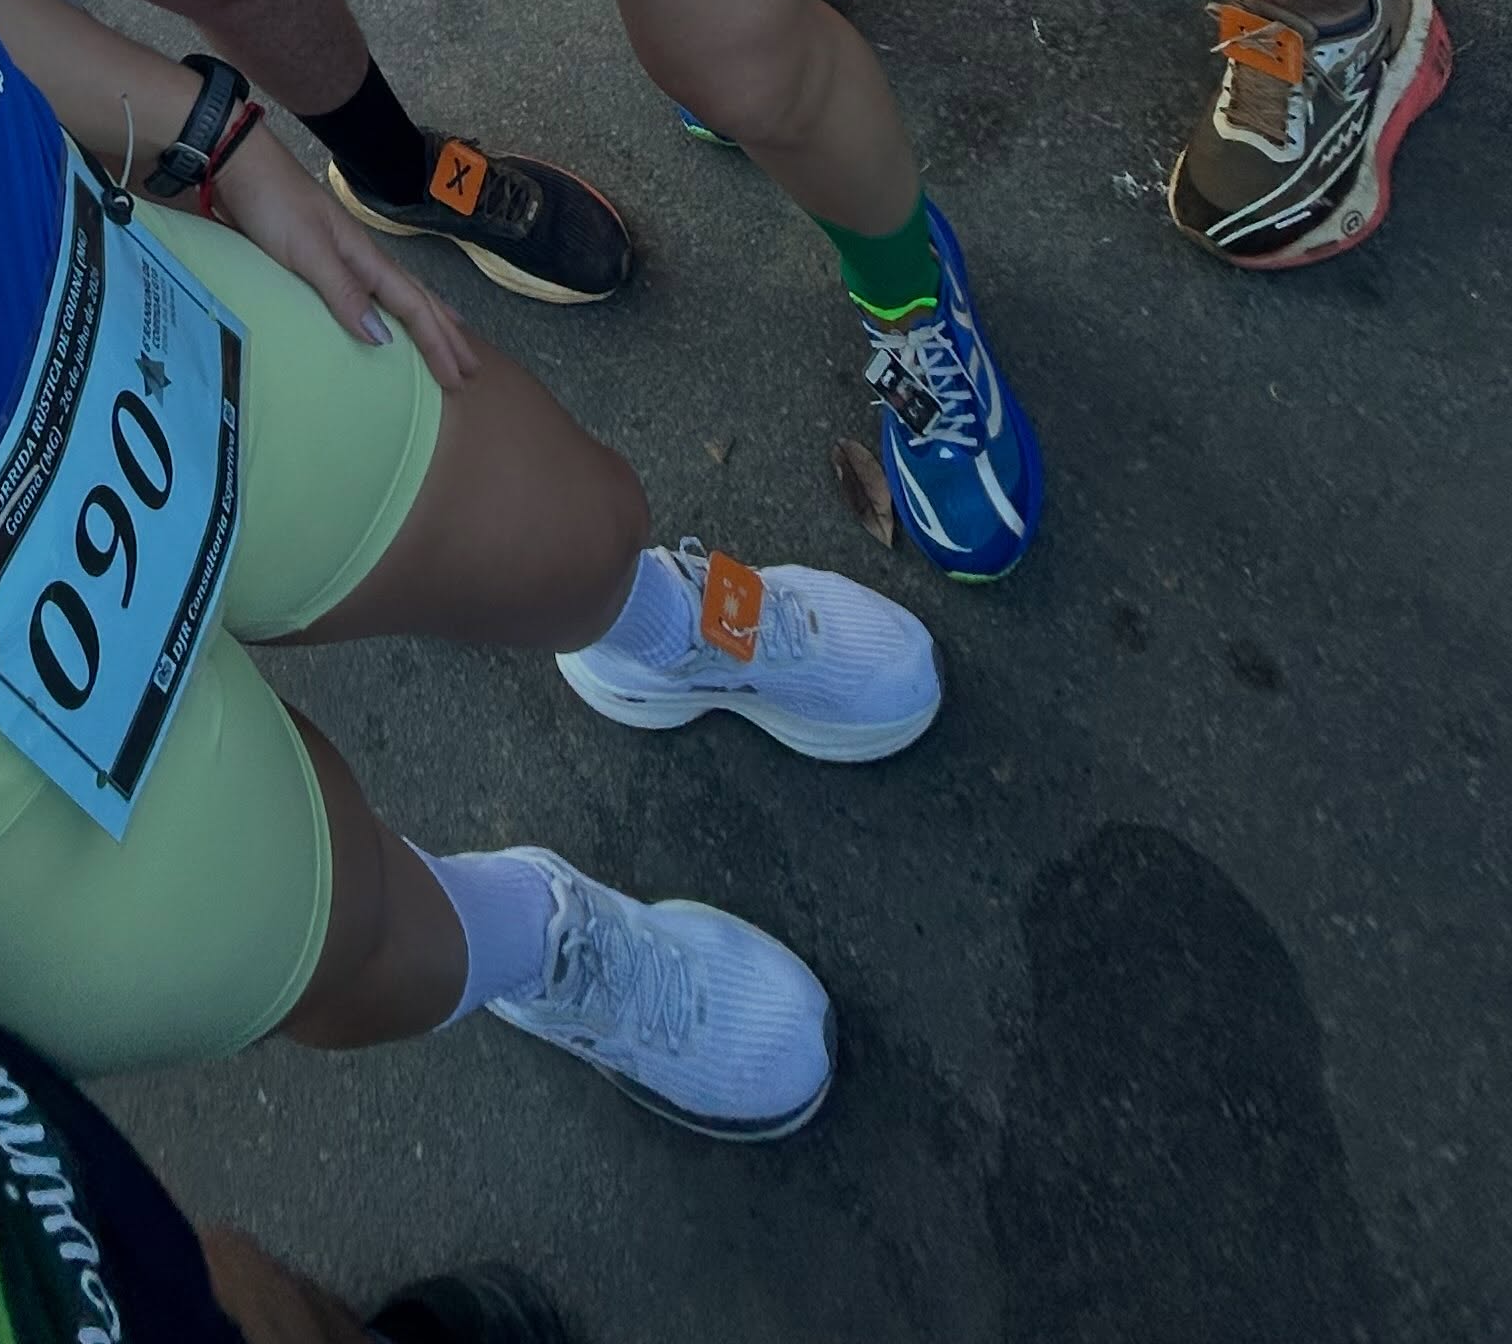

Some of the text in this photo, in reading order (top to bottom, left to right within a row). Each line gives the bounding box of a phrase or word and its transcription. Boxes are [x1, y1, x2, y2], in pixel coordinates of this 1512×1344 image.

[73, 324, 90, 372] julho
[31, 360, 64, 439] RÚSTICA
[56, 330, 70, 360] DE
[59, 388, 73, 414] 26
[68, 366, 80, 388] de
[40, 425, 63, 475] (MG)
[29, 389, 173, 711] 090
[172, 620, 191, 663] DJR
[188, 517, 229, 622] Consultoria
